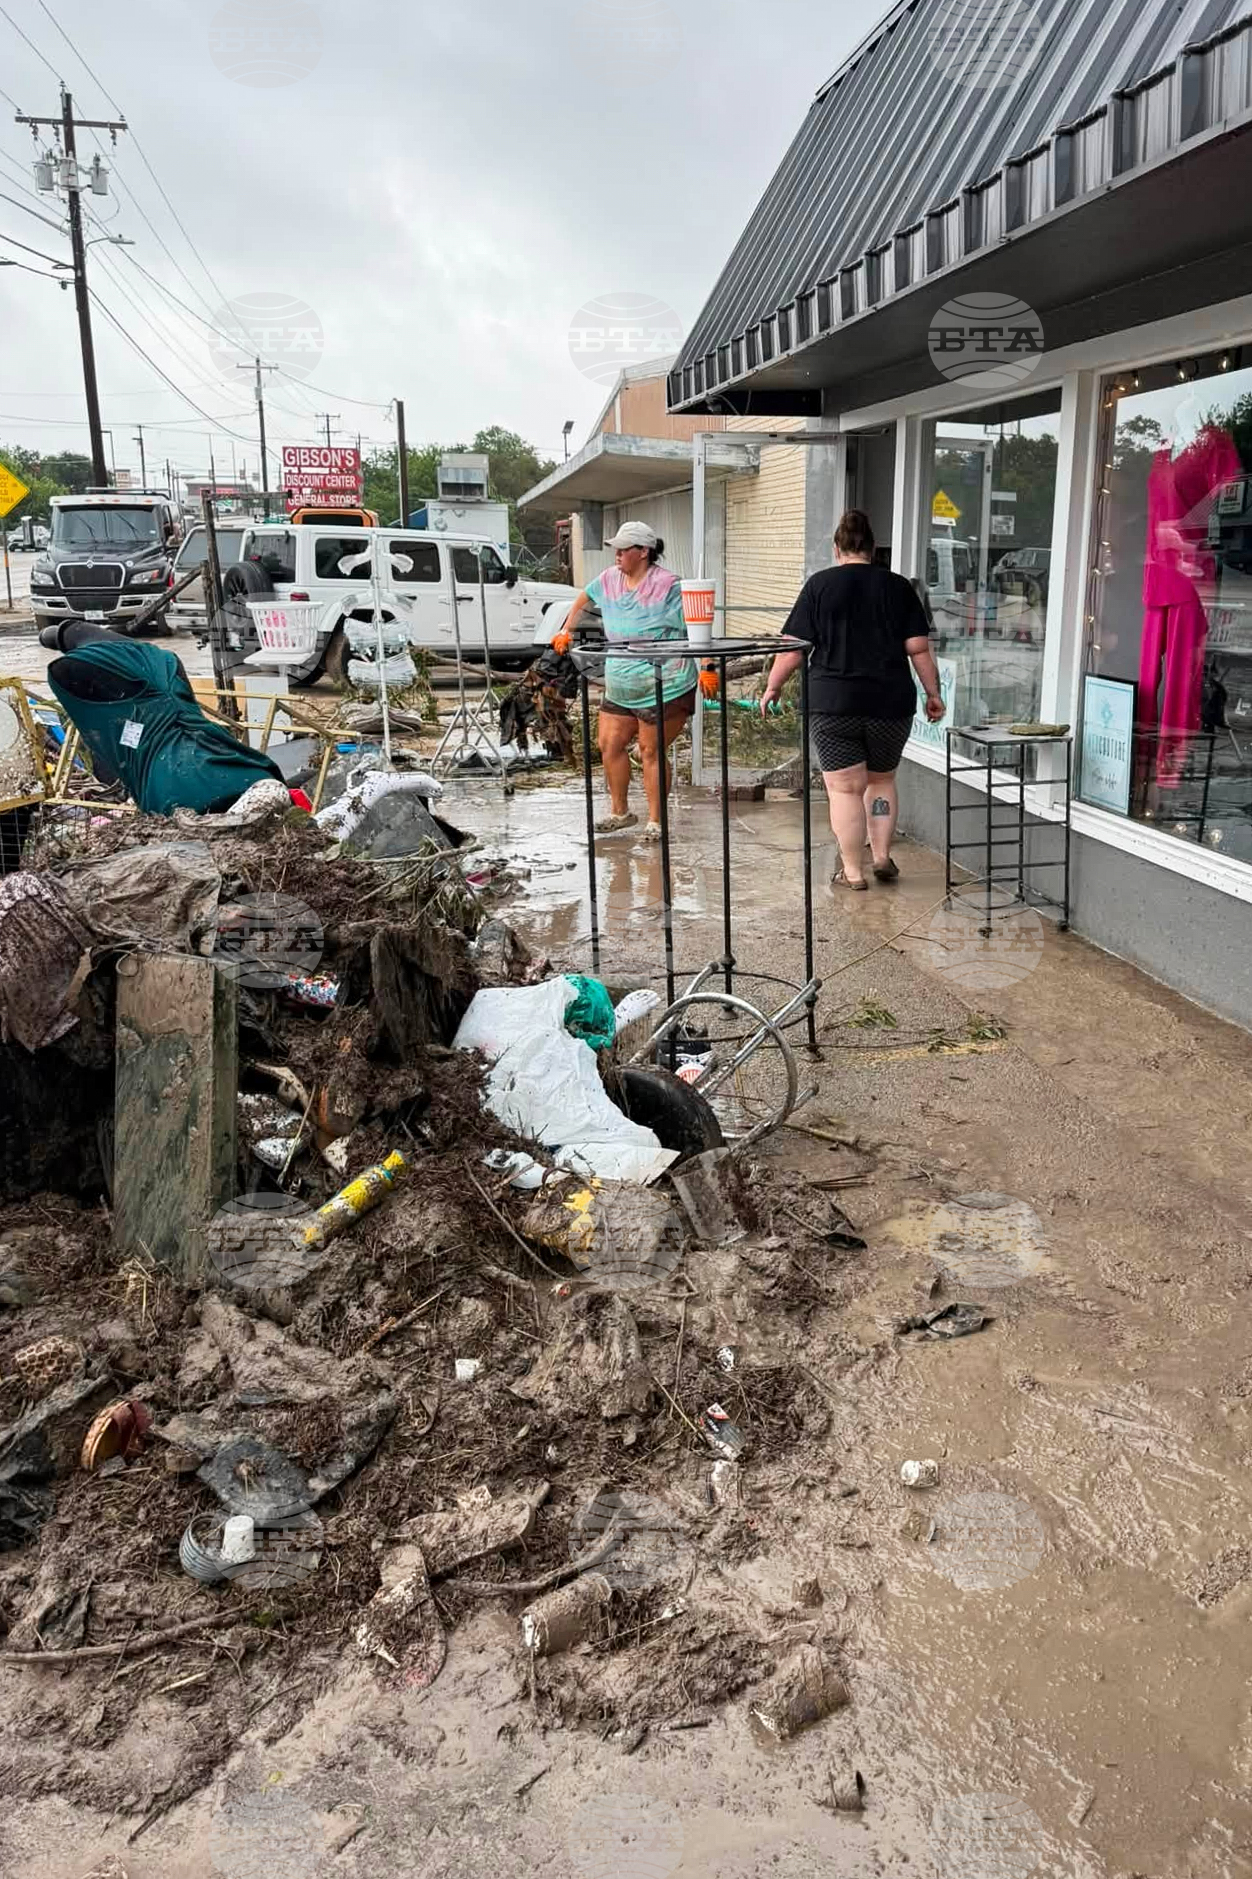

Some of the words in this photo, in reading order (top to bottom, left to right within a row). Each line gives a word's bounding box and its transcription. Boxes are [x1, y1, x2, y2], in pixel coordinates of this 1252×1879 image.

[284, 448, 355, 467] GIBSON'S
[286, 474, 324, 487] DISCOUNT
[325, 475, 356, 488] CENTER
[287, 494, 328, 506] GENERAL
[329, 494, 357, 505] STORE
[912, 720, 947, 744] STRON
